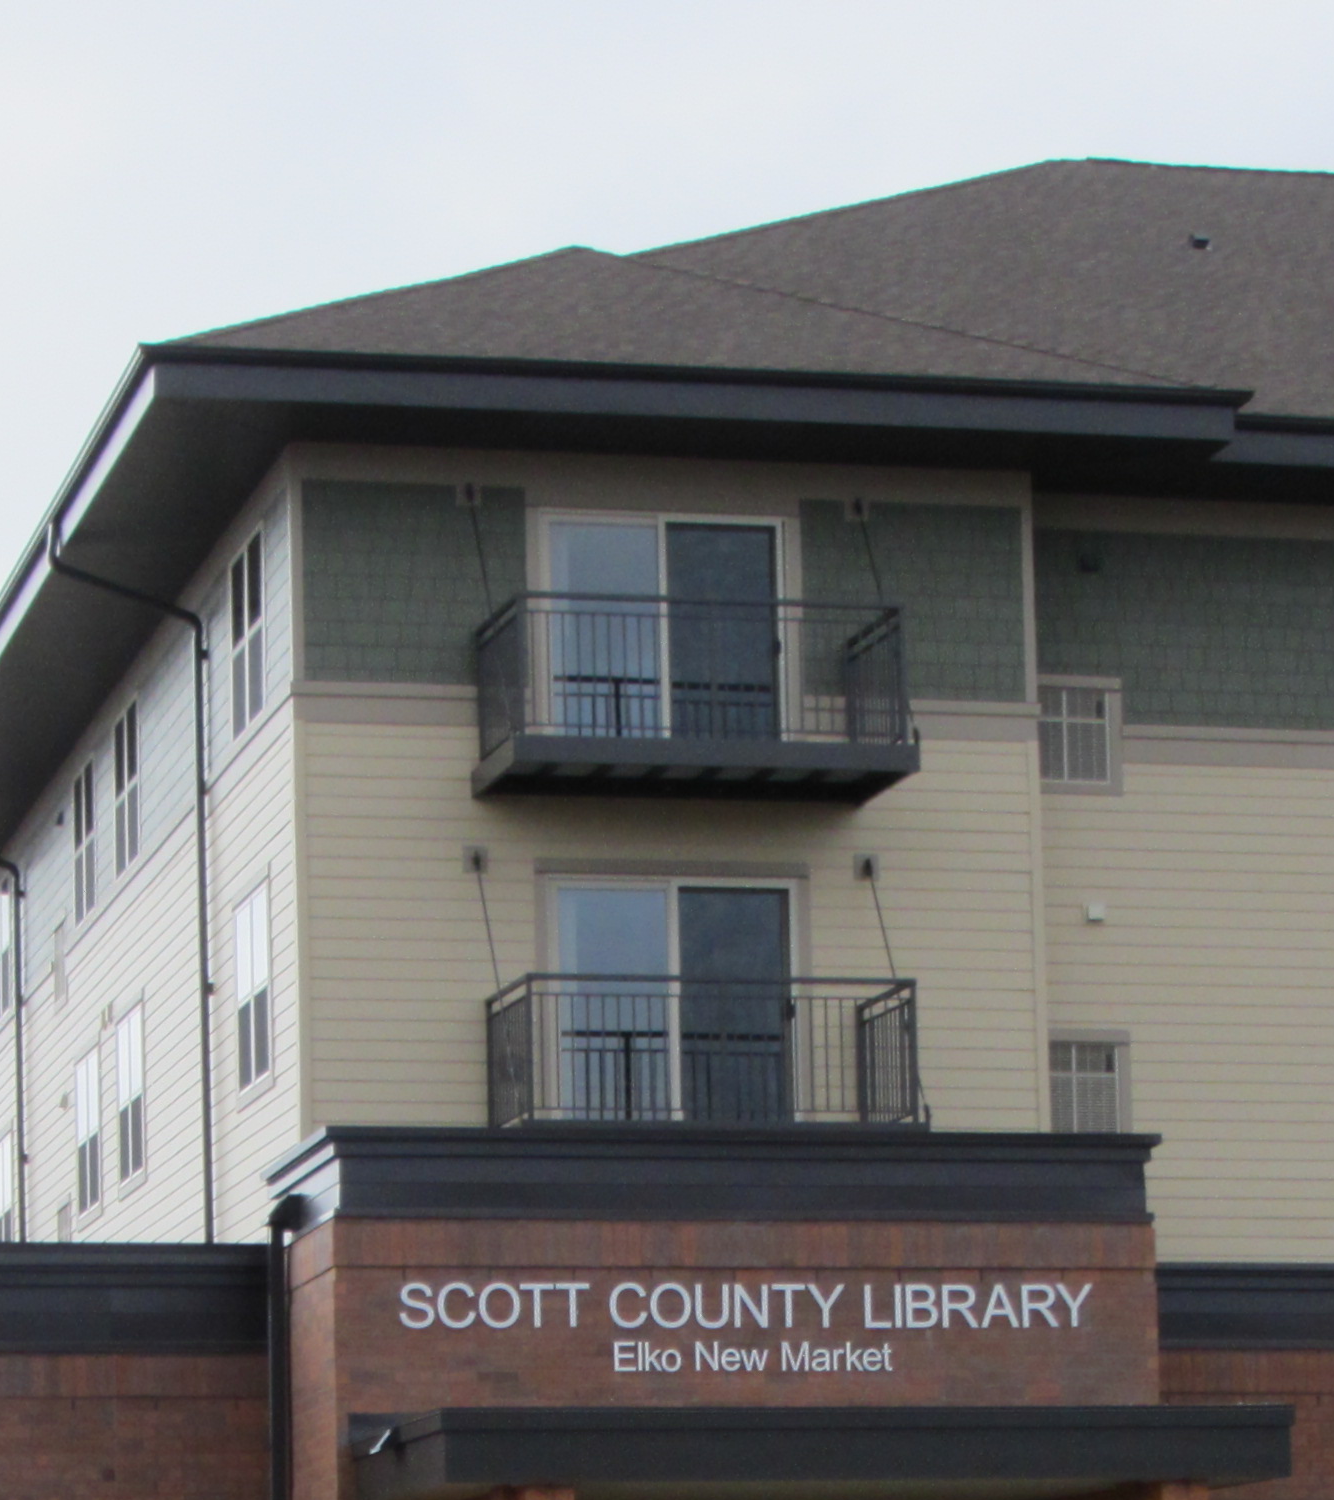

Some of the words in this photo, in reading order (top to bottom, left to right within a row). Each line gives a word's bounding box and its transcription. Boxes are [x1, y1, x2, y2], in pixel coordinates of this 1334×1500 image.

[400, 1281, 591, 1329] SCOTT
[609, 1281, 844, 1329] COUNTY
[864, 1282, 1093, 1329] LIBRARY
[613, 1340, 682, 1373] Elko
[694, 1340, 769, 1372] New
[780, 1340, 894, 1372] Market
